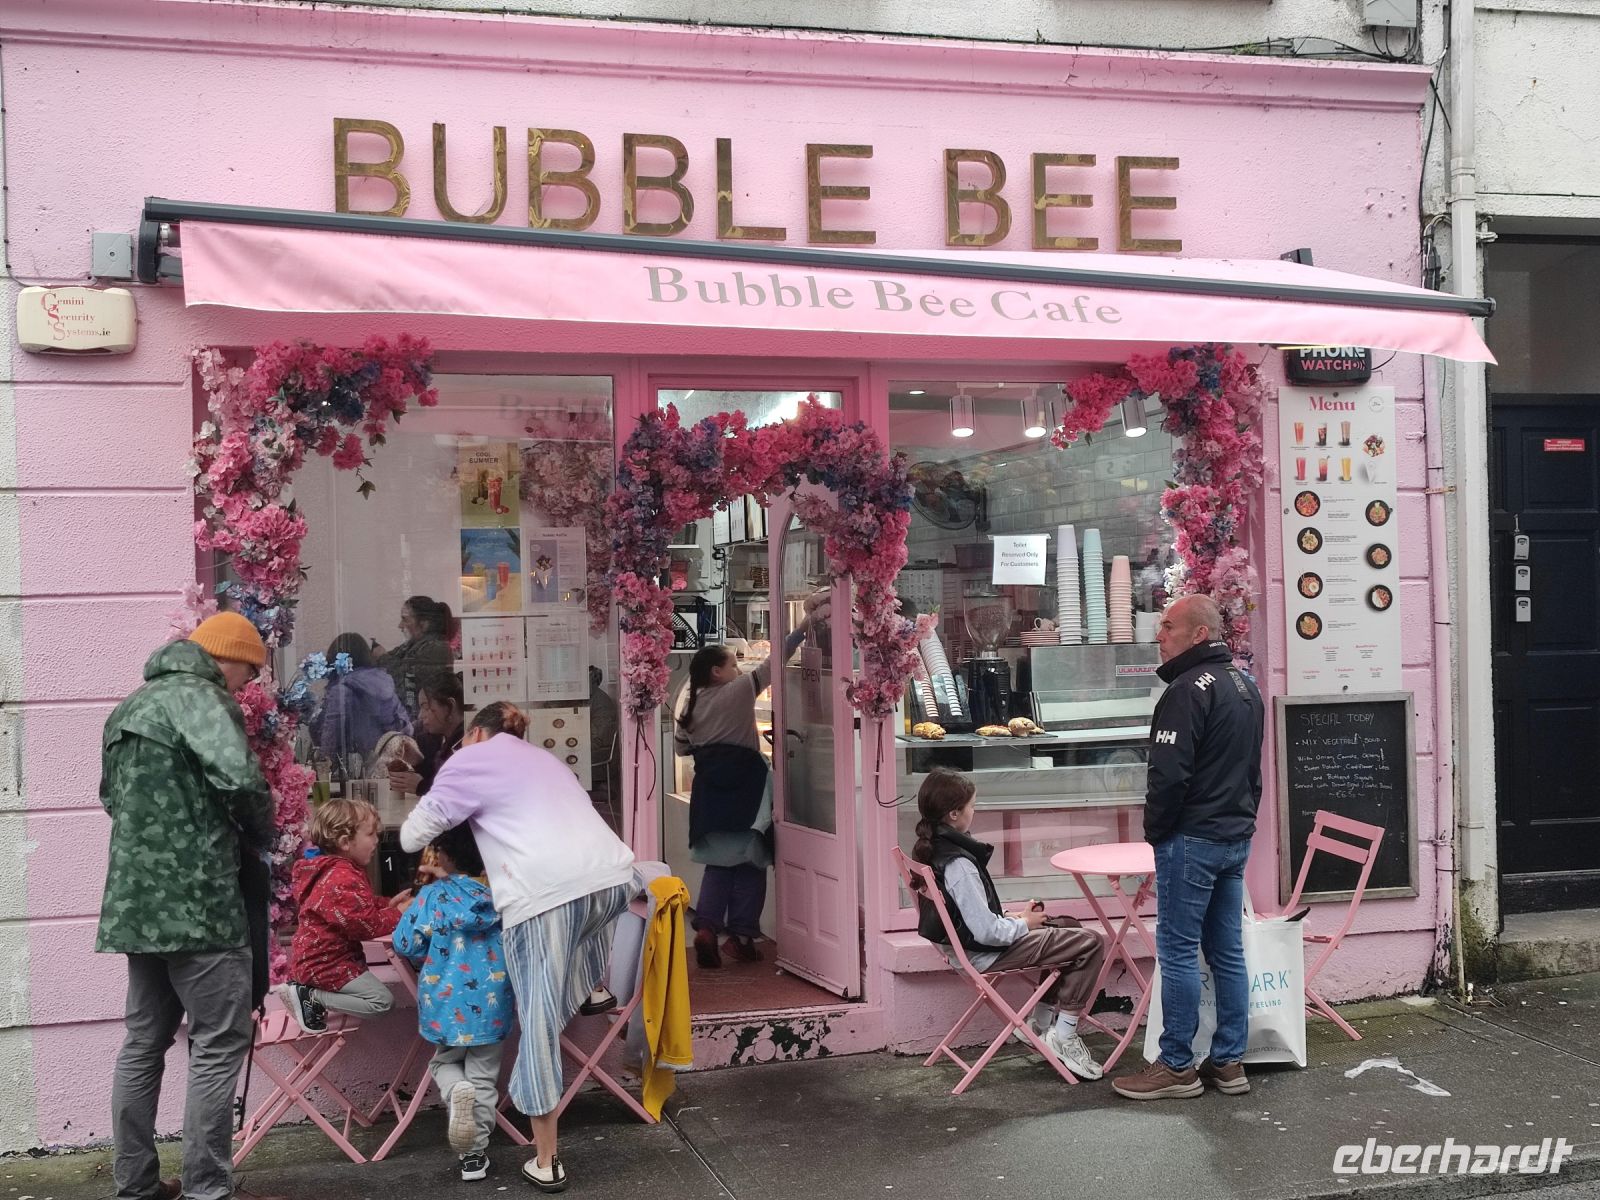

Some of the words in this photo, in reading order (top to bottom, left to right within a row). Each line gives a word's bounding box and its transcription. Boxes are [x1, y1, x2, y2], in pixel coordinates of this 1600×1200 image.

[333, 117, 876, 244] BUBBLE
[943, 148, 1183, 251] BEE
[41, 292, 84, 312] Gemini
[644, 265, 855, 310] Bubble
[868, 279, 976, 318] Bee
[990, 289, 1123, 324] Cafe
[48, 307, 95, 324] Security
[53, 322, 111, 341] Systems.ie
[1300, 346, 1366, 358] PHONE
[1302, 360, 1352, 370] WATCH
[1310, 396, 1355, 411] Menu
[801, 668, 821, 683] OPEN
[1155, 730, 1177, 744] HH
